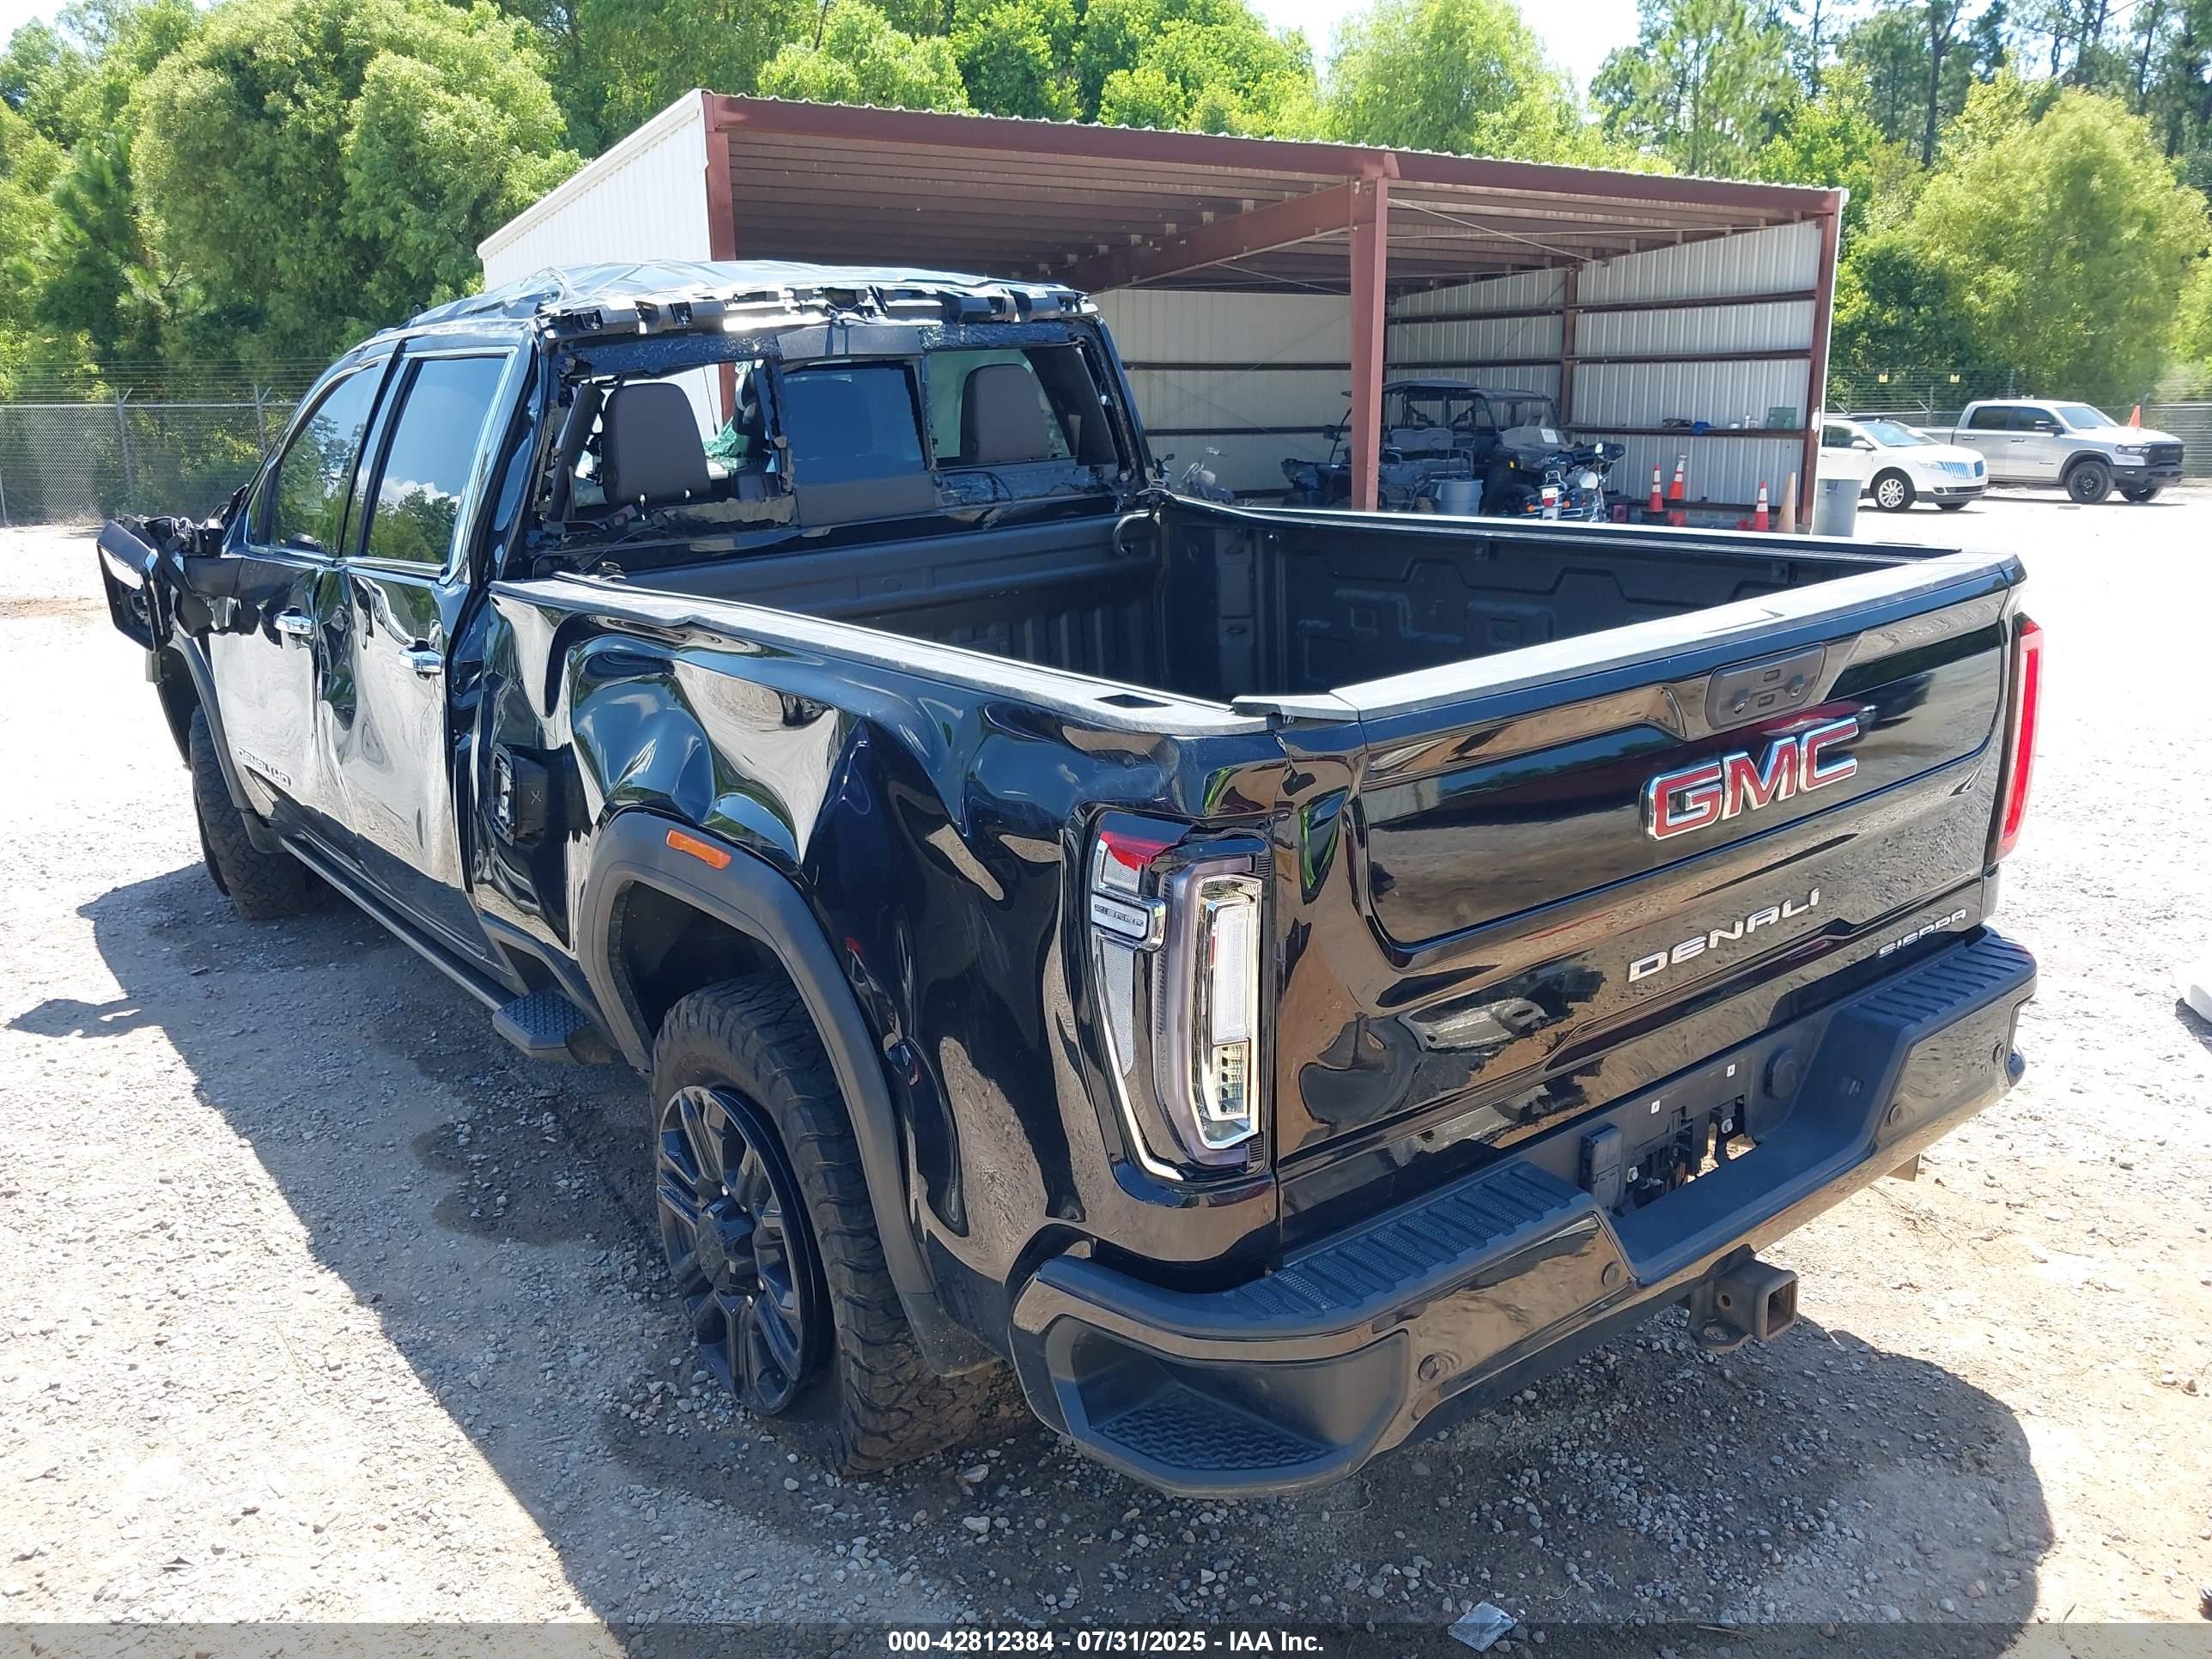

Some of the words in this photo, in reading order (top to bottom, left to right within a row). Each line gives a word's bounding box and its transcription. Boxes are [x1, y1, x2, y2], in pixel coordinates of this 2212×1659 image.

[1640, 717, 1860, 841] GMC
[1628, 887, 1820, 983] DENALI
[1878, 908, 1967, 958] SIERRA
